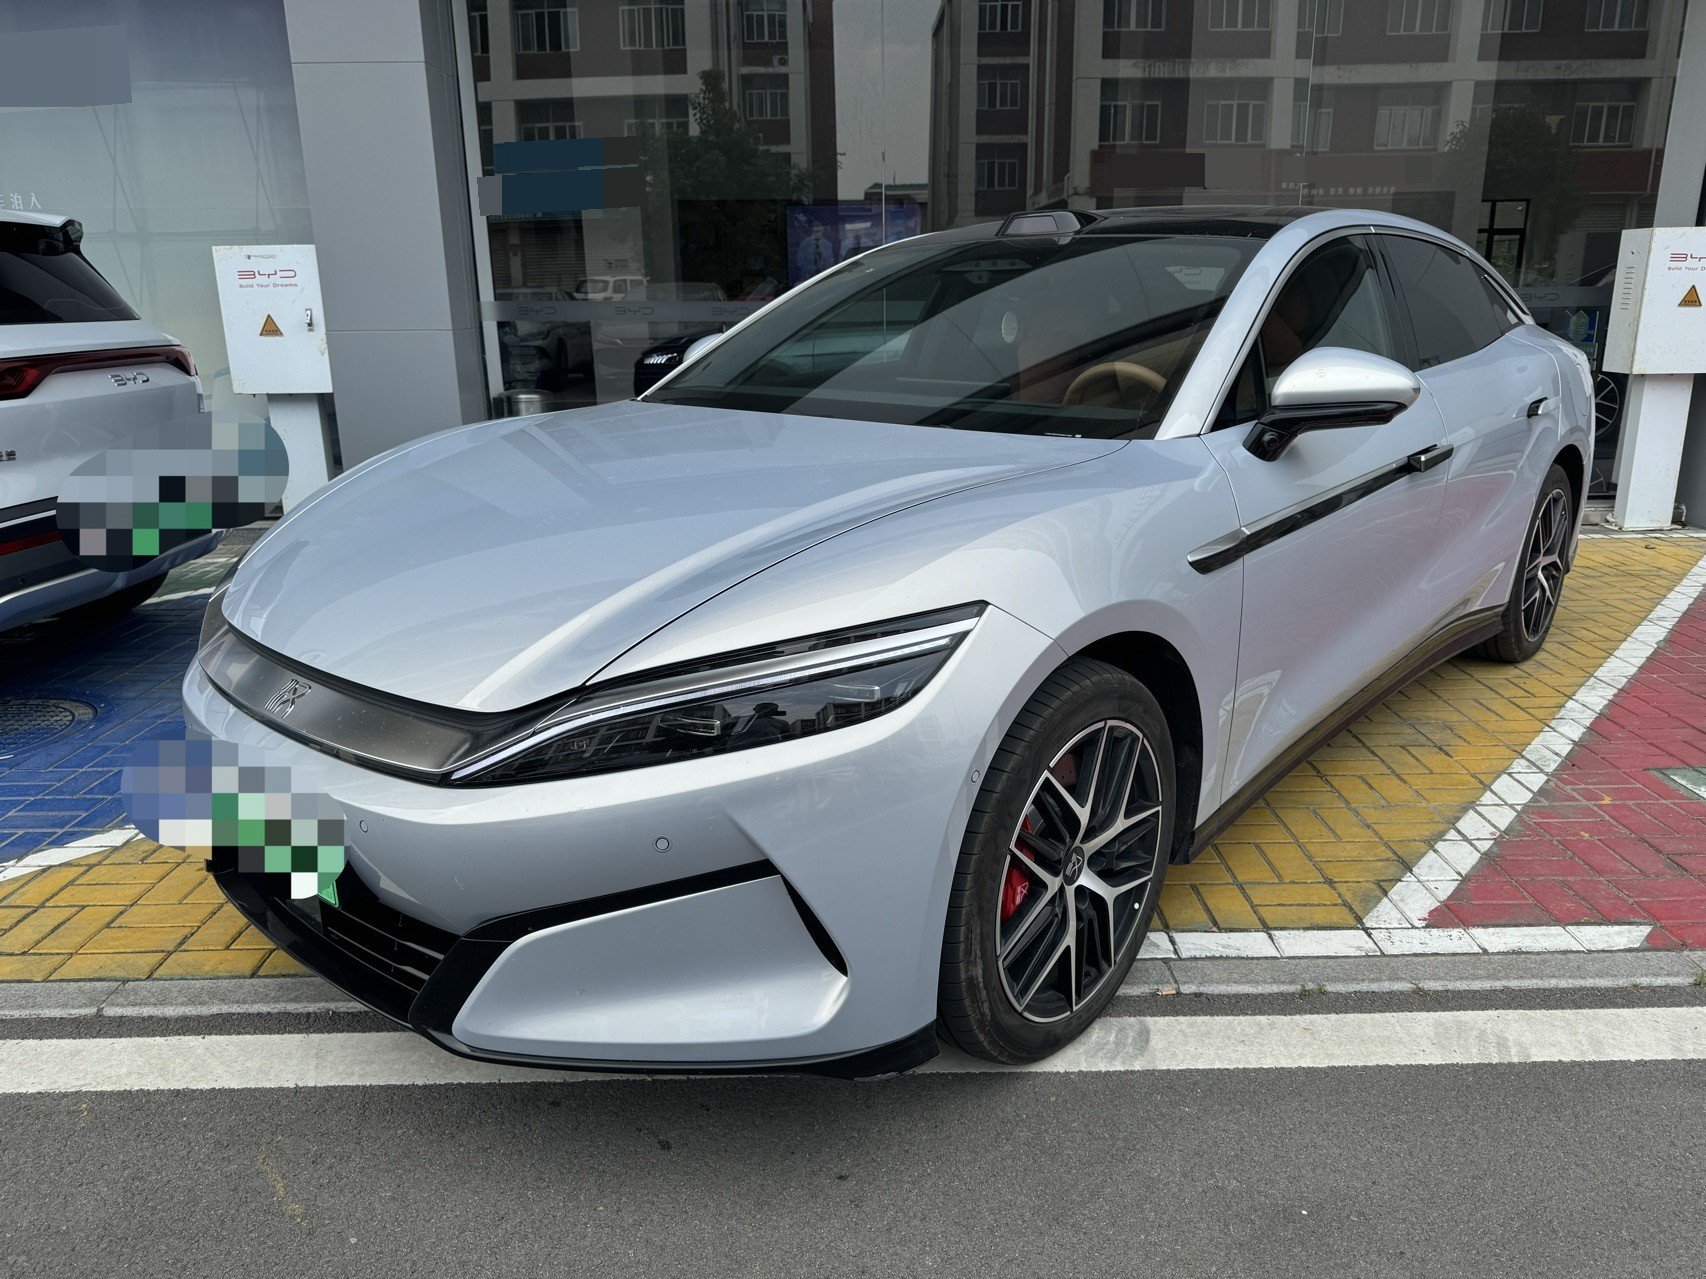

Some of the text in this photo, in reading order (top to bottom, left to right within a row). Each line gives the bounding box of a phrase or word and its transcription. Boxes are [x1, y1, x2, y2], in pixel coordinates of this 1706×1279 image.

[1669, 253, 1706, 262] BY
[237, 269, 297, 280] BYD
[1521, 292, 1560, 301] BYD
[517, 306, 557, 316] BYD
[613, 306, 654, 316] BYD
[711, 307, 751, 316] BYD
[108, 371, 150, 387] BYD
